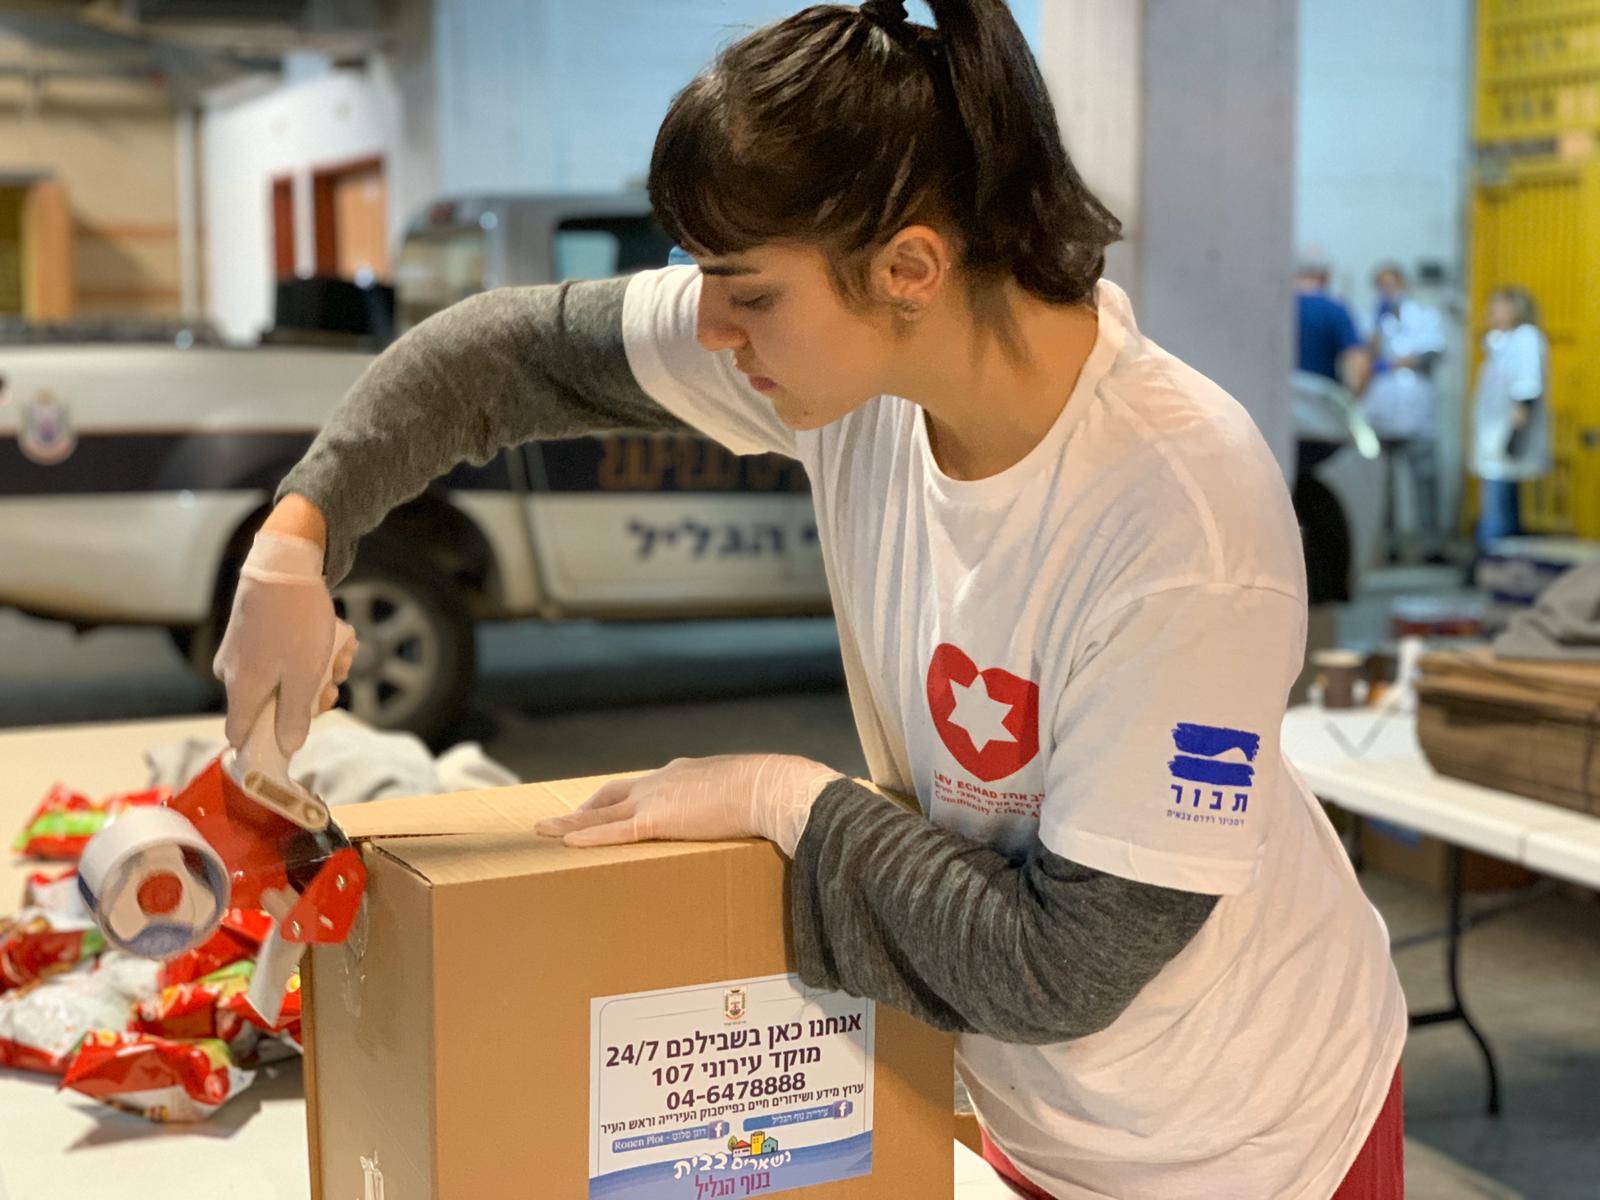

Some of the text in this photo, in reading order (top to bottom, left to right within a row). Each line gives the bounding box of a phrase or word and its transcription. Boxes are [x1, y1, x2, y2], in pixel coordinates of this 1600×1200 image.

[934, 770, 998, 799] LEV ECHAD
[1170, 783, 1248, 813] תבור
[935, 790, 991, 815] Community
[605, 1013, 862, 1068] אנחנו כאן בשבילכם 24/7
[652, 1046, 821, 1087] מוקד עירוני 107
[666, 1072, 806, 1110] 04-6478888
[601, 1083, 864, 1134] ערוץ מידע ושידורים חיים בפייסבוק העירייה וראש העיר
[614, 1137, 645, 1150] Ronen
[646, 1135, 664, 1146] Plot
[673, 1150, 791, 1180] נשארים בבית
[695, 1172, 771, 1200] בנוף הגליל
